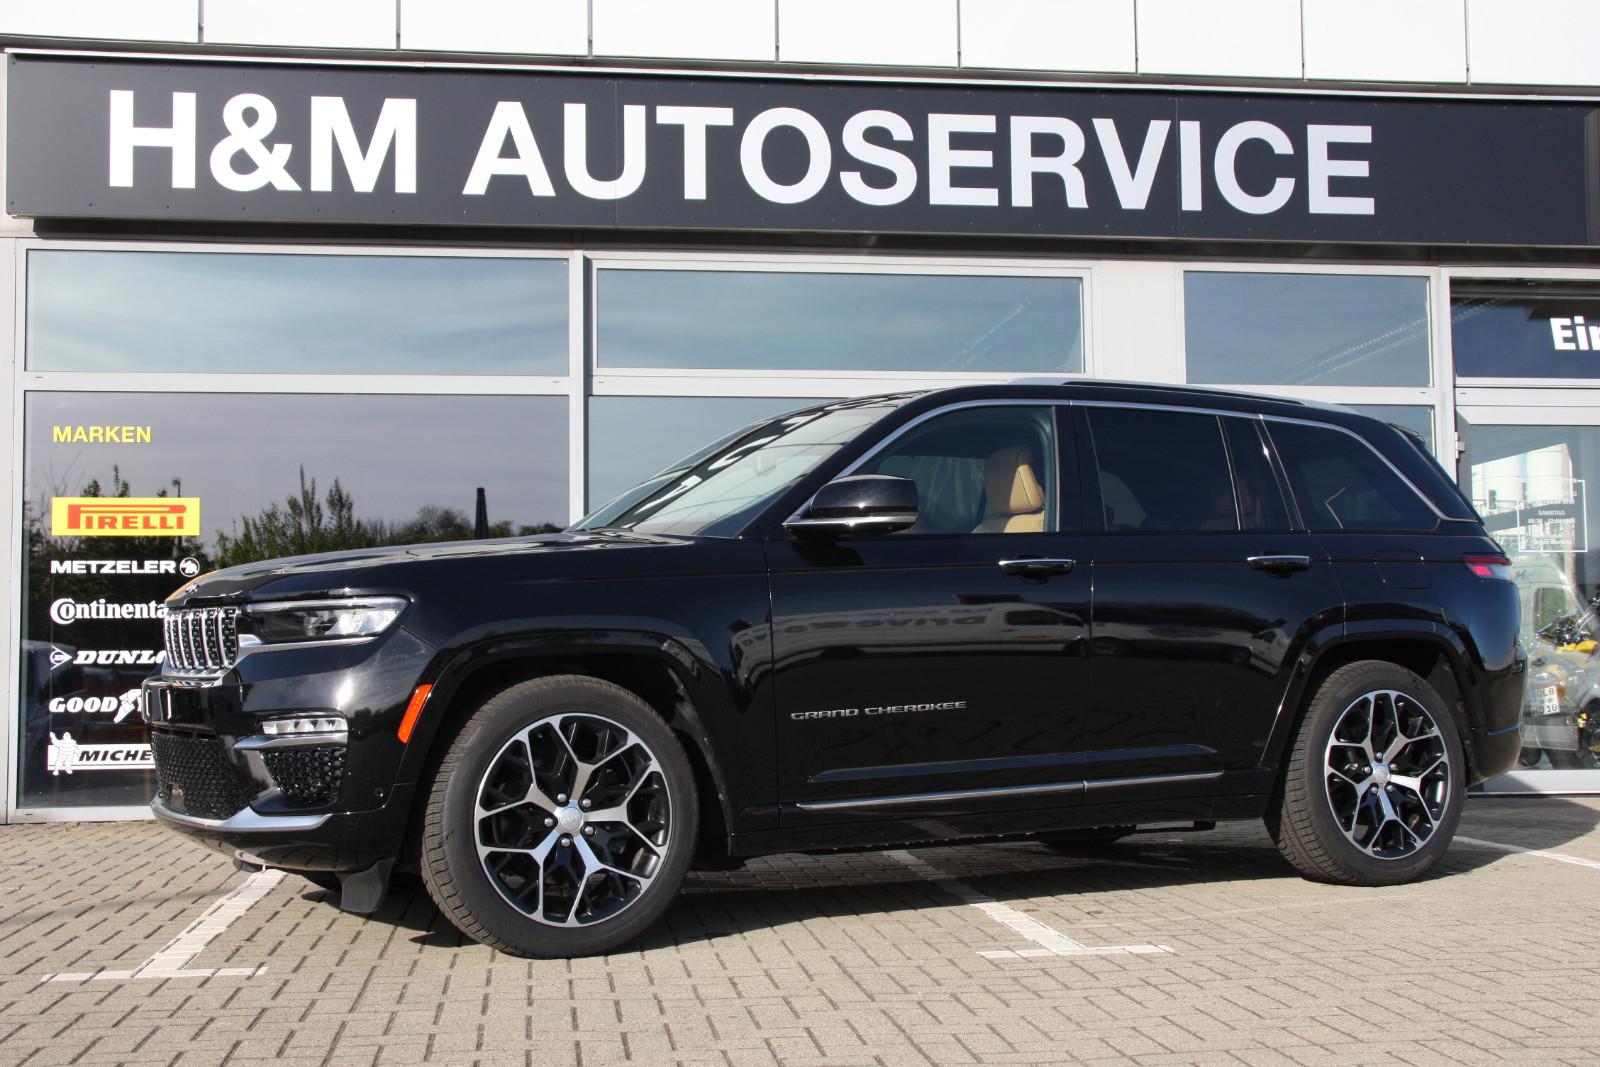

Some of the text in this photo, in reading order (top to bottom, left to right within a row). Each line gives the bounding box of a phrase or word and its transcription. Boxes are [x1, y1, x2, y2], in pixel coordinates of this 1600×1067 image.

[108, 89, 1376, 216] H&M AUTOSERVICE
[52, 425, 152, 444] MARKEN
[67, 504, 187, 530] PIRELLI
[50, 560, 176, 574] METZELER
[50, 597, 166, 624] Continenta
[73, 650, 166, 665] DUNL
[49, 696, 142, 713] GOOD
[790, 700, 968, 720] GRAND CHEROKEE
[79, 750, 153, 762] MICHE
